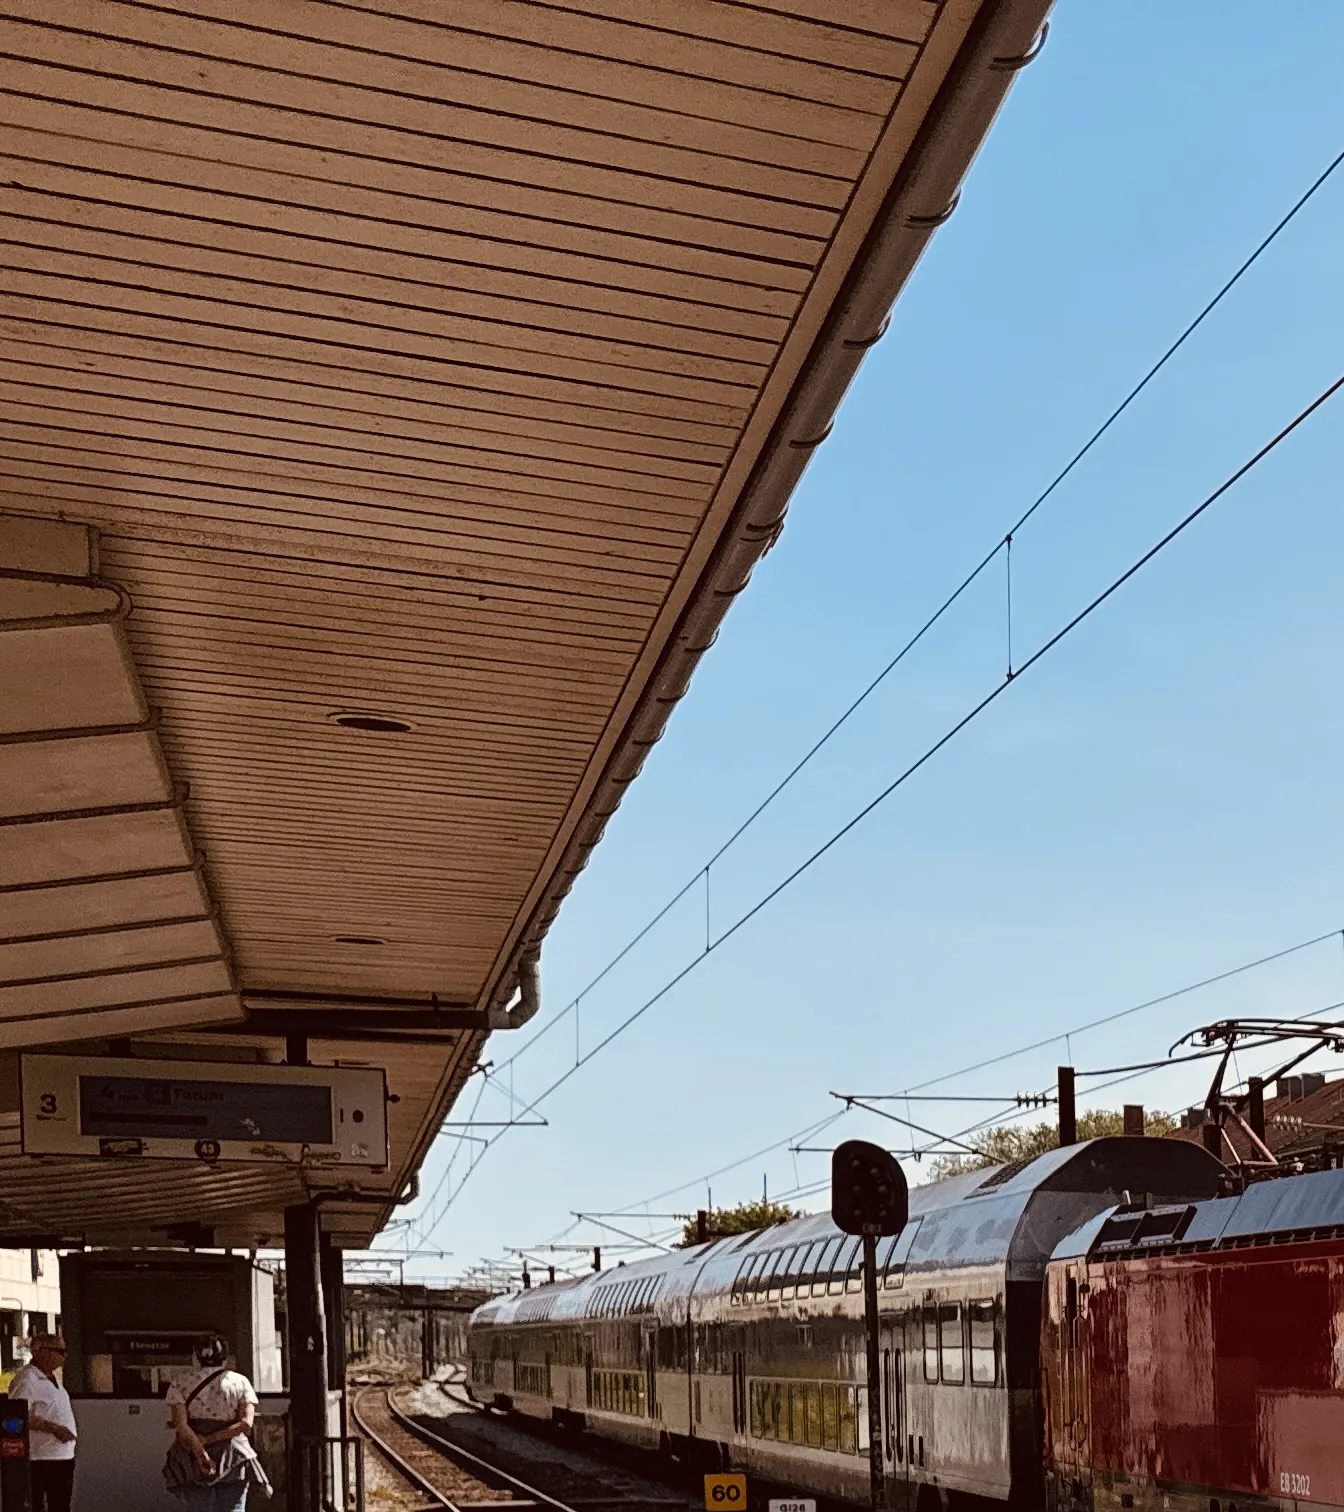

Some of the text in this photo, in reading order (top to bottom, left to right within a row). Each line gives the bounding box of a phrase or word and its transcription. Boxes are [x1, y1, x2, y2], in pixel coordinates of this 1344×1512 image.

[40, 1093, 57, 1113] 3
[711, 1484, 741, 1503] 60
[1291, 1473, 1311, 1496] 3202
